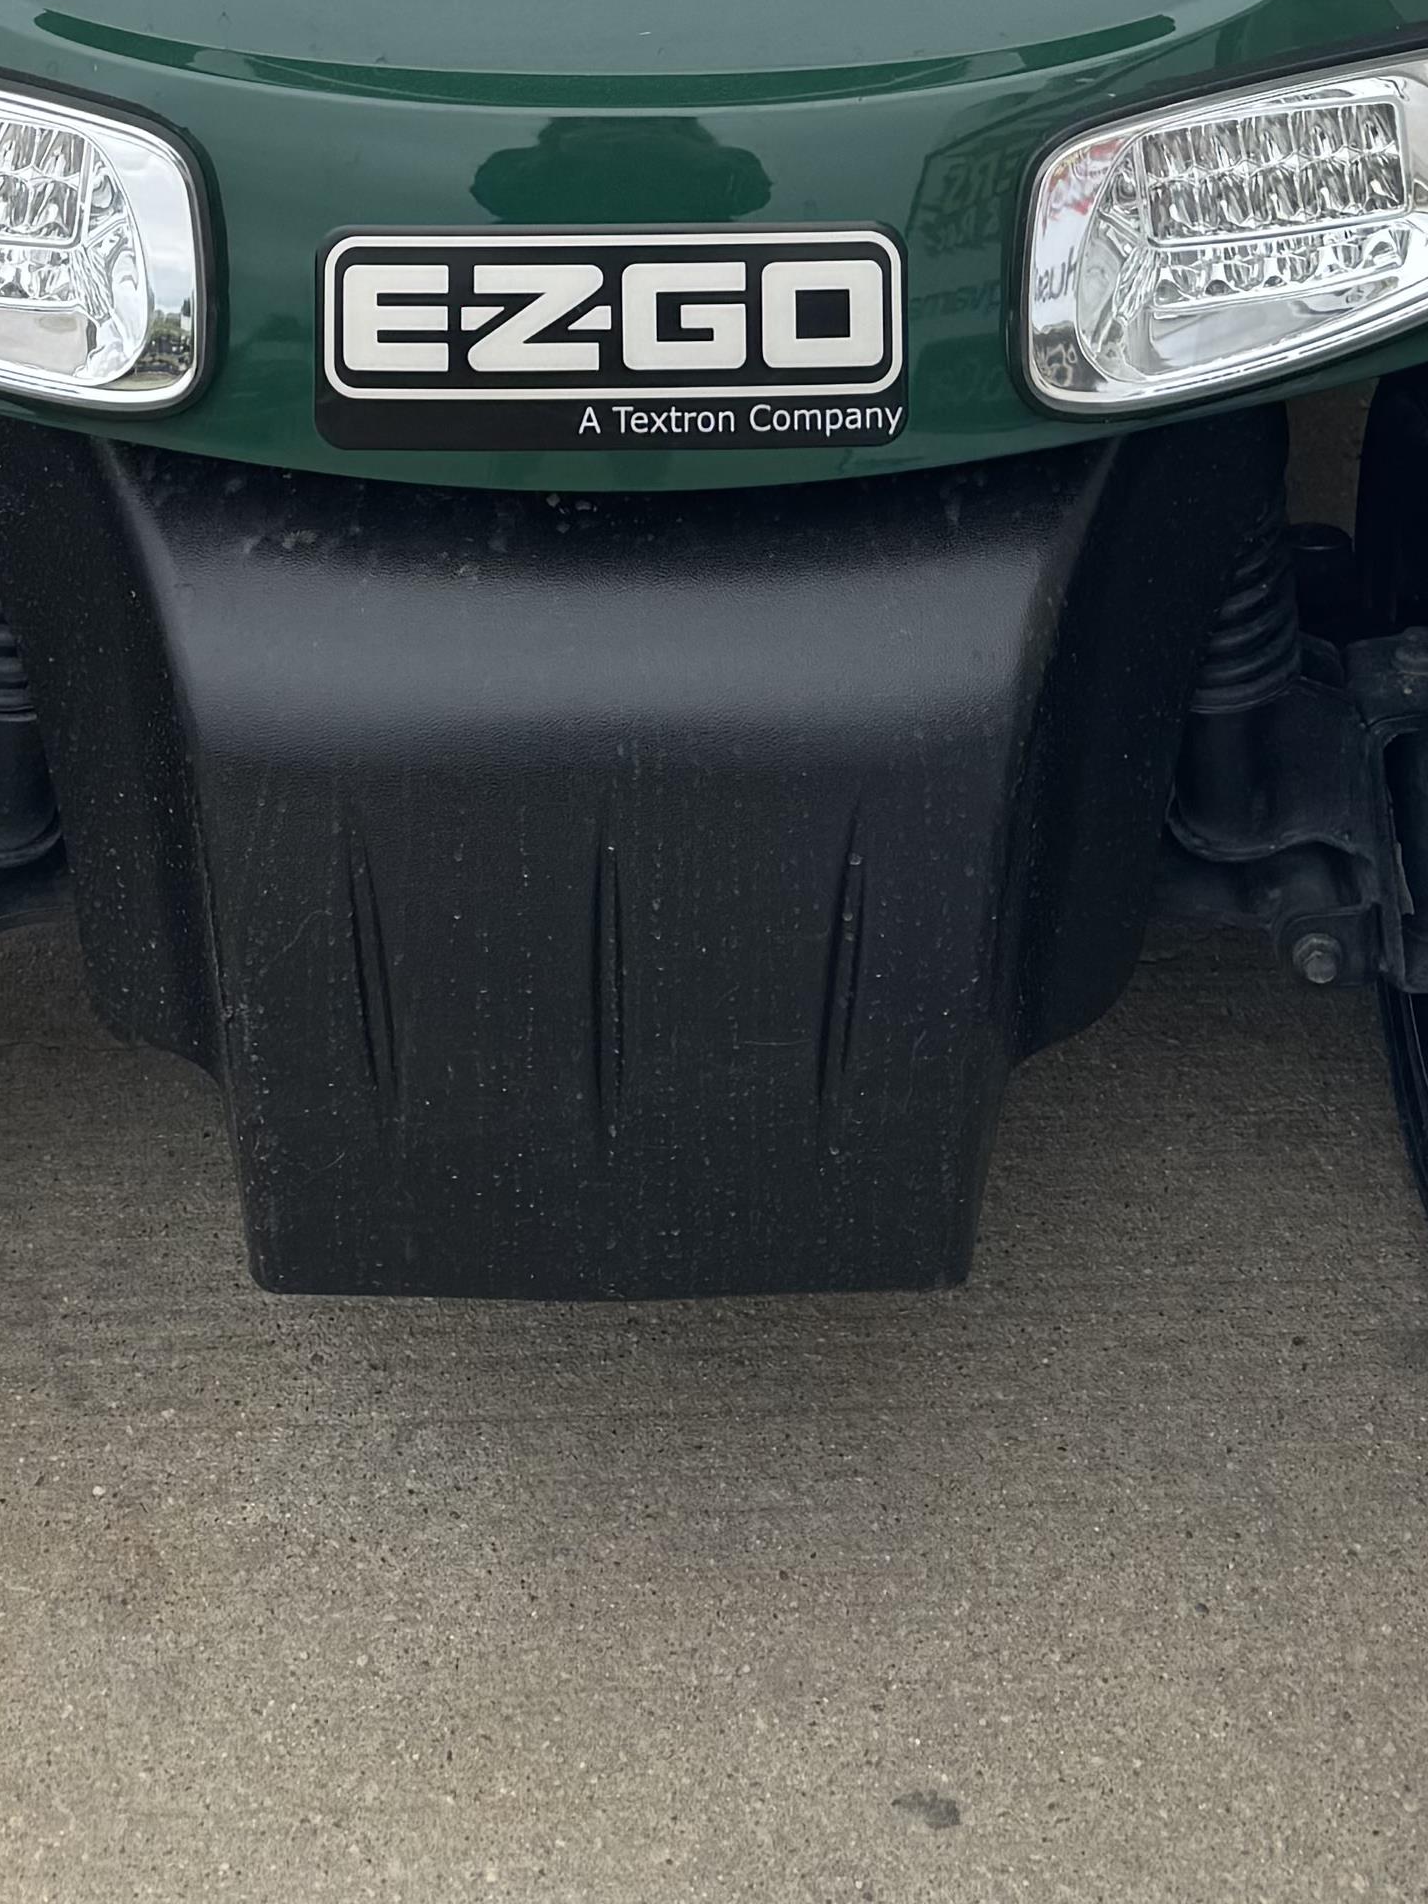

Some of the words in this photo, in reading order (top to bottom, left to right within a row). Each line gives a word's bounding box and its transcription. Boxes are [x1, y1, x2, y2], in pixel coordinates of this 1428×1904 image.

[578, 405, 602, 435] A
[612, 405, 736, 435] Textron
[748, 403, 905, 438] Company
